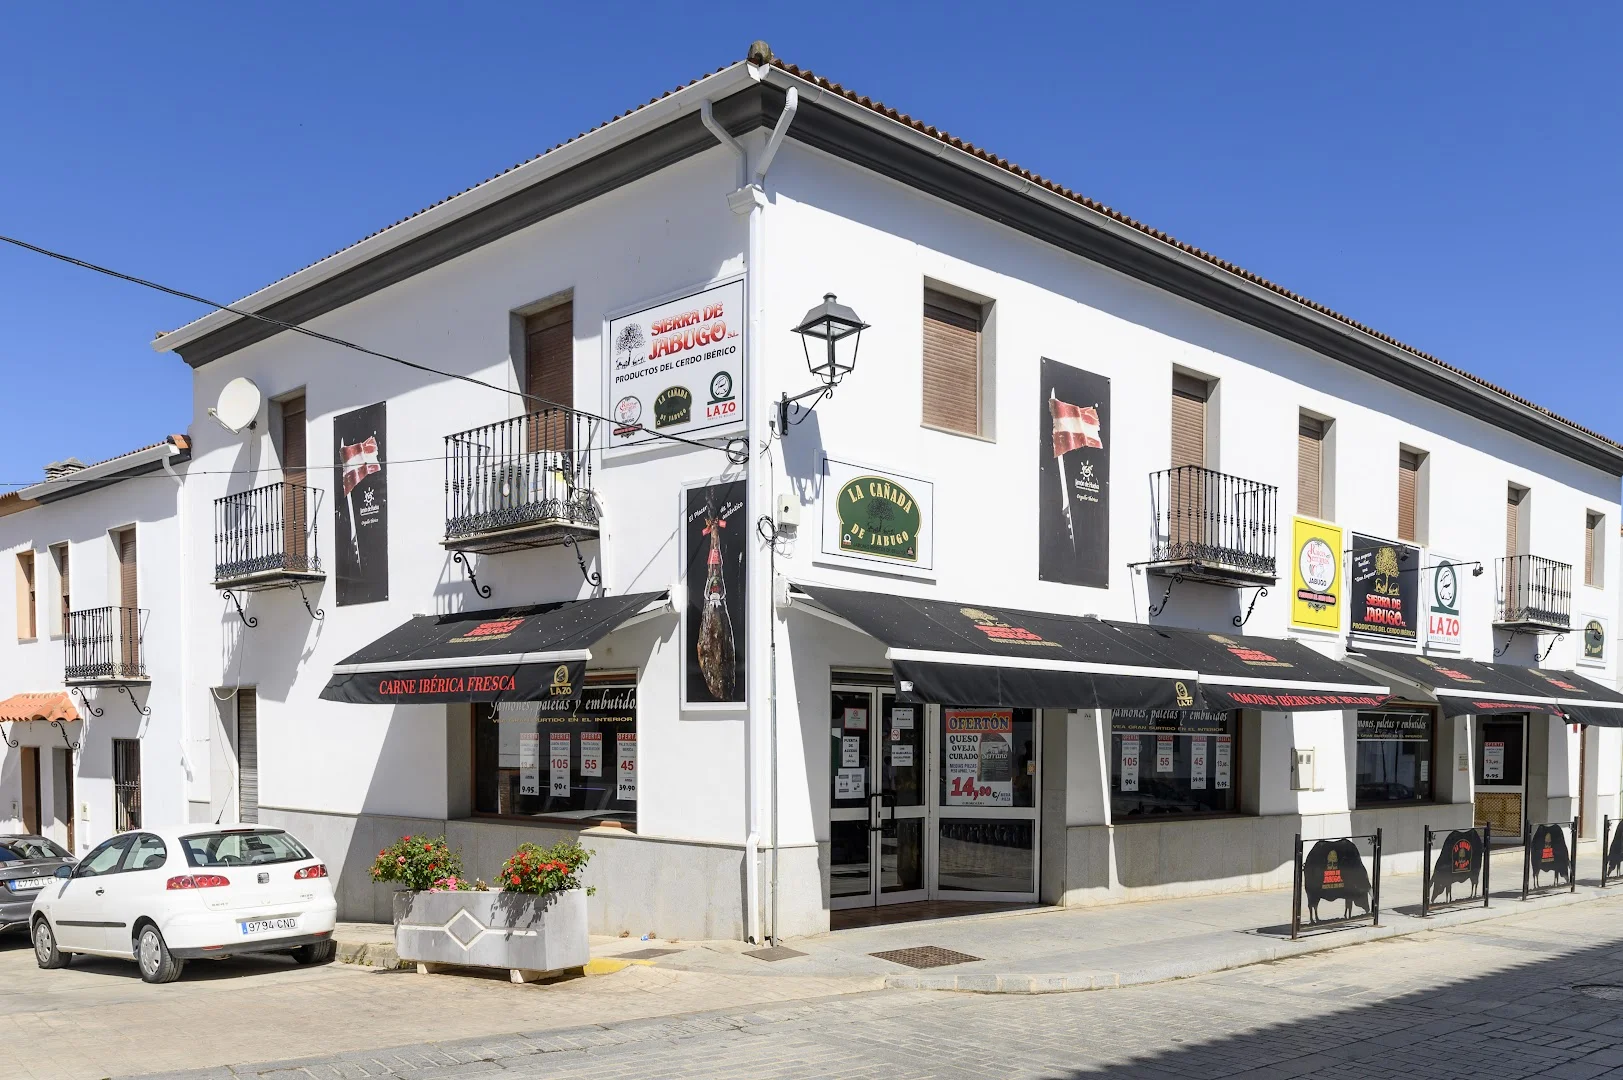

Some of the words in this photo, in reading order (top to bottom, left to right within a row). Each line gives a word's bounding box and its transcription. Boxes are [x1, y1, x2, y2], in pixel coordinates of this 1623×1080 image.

[651, 309, 700, 336] SIERRA
[703, 302, 724, 321] DE
[648, 320, 727, 361] JABUGO
[615, 366, 658, 384] PRODUCTOS
[660, 362, 674, 373] DEL
[675, 354, 702, 368] CERDO
[703, 345, 736, 361] IBÉRICO
[658, 395, 666, 405] LA
[706, 401, 737, 418] LAZO
[848, 485, 865, 503] LA
[869, 482, 913, 514] CAÑADA
[851, 523, 866, 539] DE
[870, 530, 909, 546] JABUGO
[1366, 593, 1390, 608] SIERRA
[1391, 598, 1401, 610] DE
[1364, 606, 1402, 626] JABUGO
[1429, 615, 1460, 637] LAZO
[380, 680, 416, 695] CARNE
[419, 674, 464, 694] IBÉRICA
[467, 675, 516, 692] FRESCA
[550, 686, 572, 696] LAZO
[572, 700, 582, 718] y
[585, 688, 637, 711] embutido
[949, 713, 1009, 730] OFERTÓN
[581, 732, 601, 740] OFERTA
[950, 735, 978, 743] QUESO
[551, 759, 568, 769] 105
[585, 759, 597, 769] 55
[621, 760, 634, 770] 45
[1122, 757, 1138, 767] 105
[1160, 757, 1170, 766] 55
[1194, 757, 1204, 766] 45
[950, 776, 992, 801] 14,90
[17, 878, 40, 888] 4770
[249, 921, 274, 932] 9794
[277, 918, 296, 929] CND
